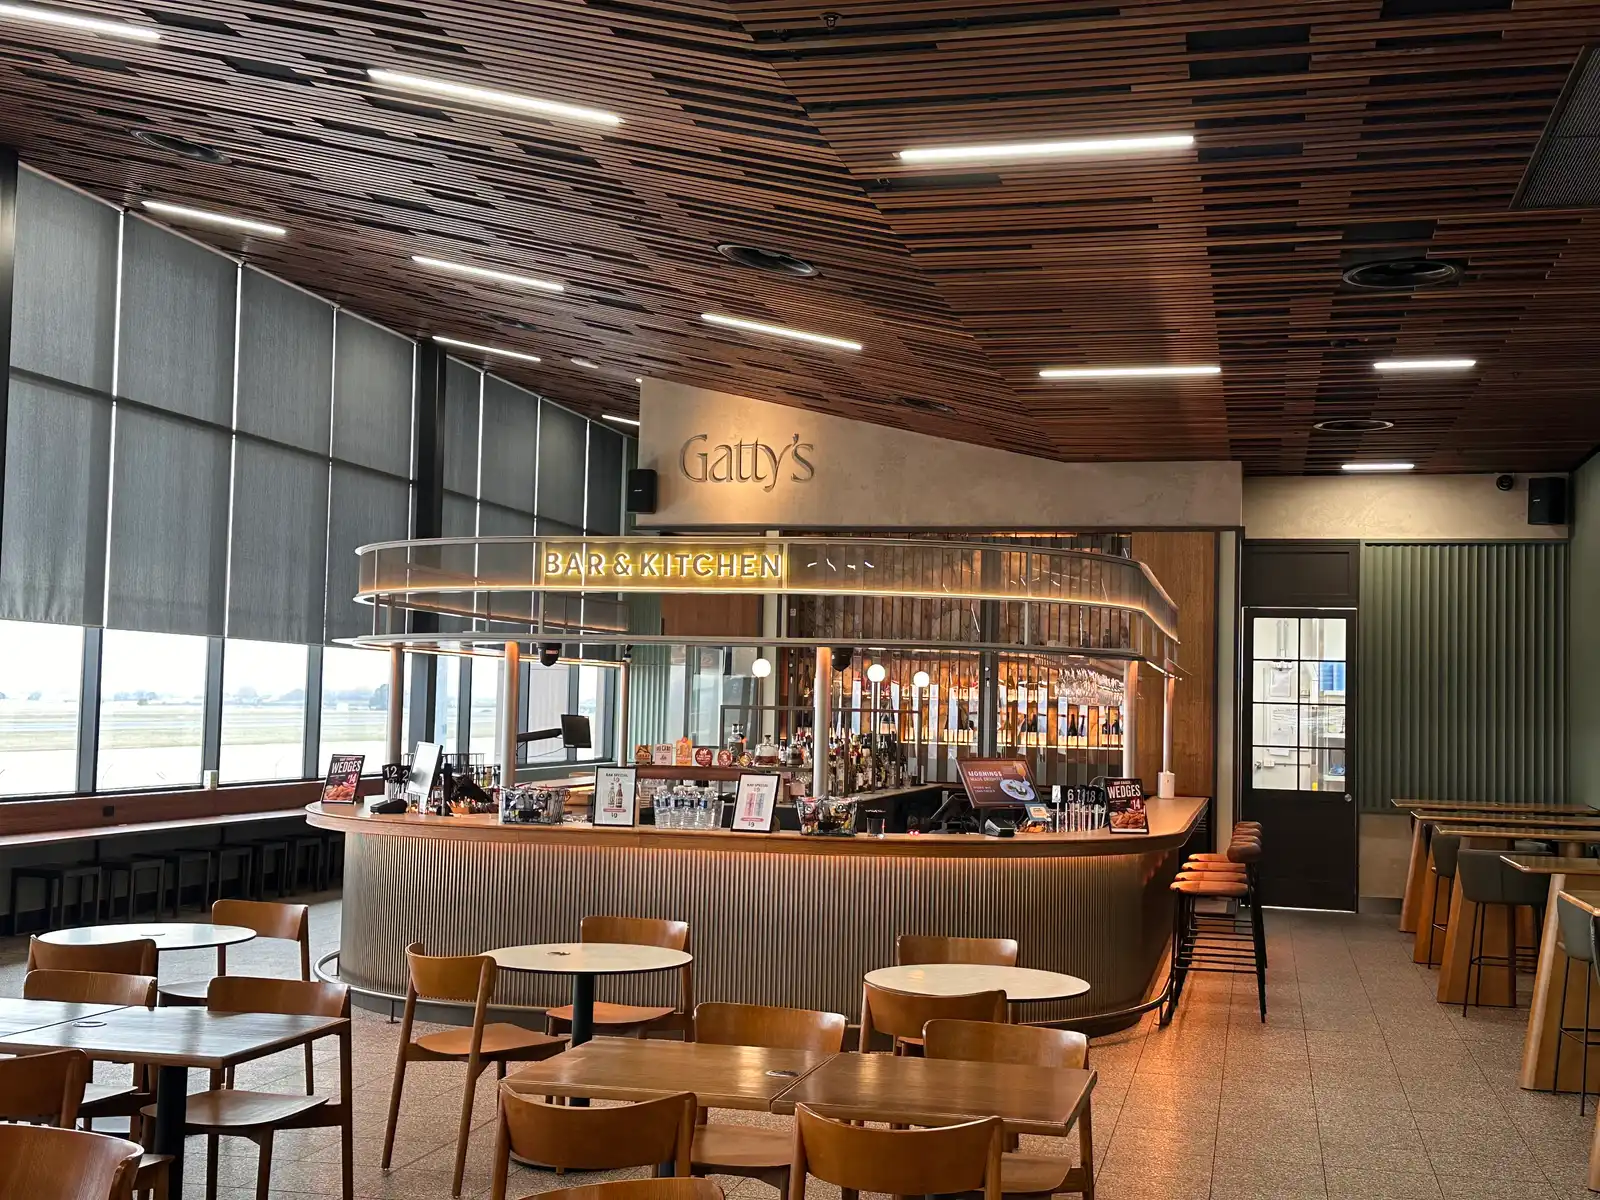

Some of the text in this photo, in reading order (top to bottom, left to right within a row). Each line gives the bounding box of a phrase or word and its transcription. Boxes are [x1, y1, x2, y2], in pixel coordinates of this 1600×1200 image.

[679, 433, 815, 493] Gatty's
[545, 552, 782, 578] BAR & KITCHEN
[331, 760, 362, 774] WEDGES
[384, 765, 398, 779] 12
[1067, 788, 1074, 801] 6
[1106, 784, 1141, 799] WEDGES
